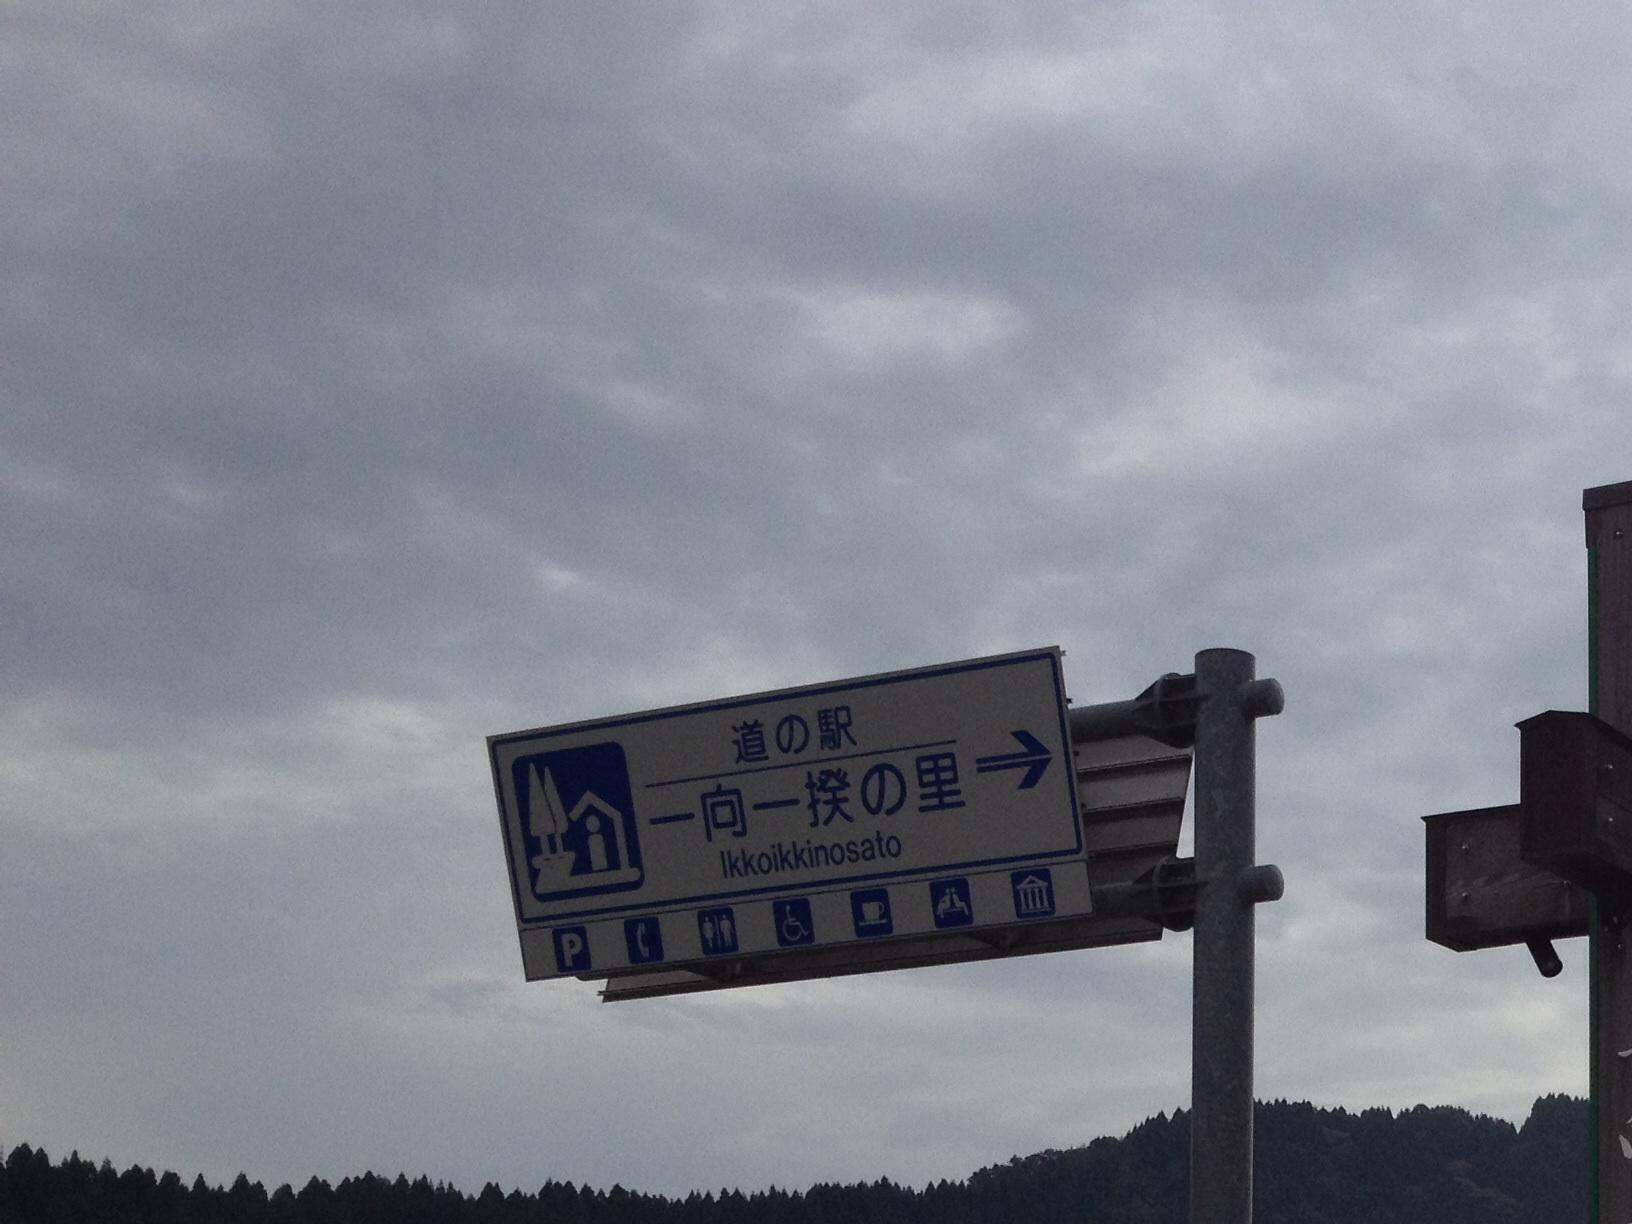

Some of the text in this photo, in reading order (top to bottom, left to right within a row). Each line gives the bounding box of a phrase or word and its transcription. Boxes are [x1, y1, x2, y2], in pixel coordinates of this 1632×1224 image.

[731, 706, 858, 764] 道の駅
[648, 751, 966, 843] 一向一揆の里
[719, 829, 903, 880] Ikkoikkinosato
[560, 932, 583, 968] P
